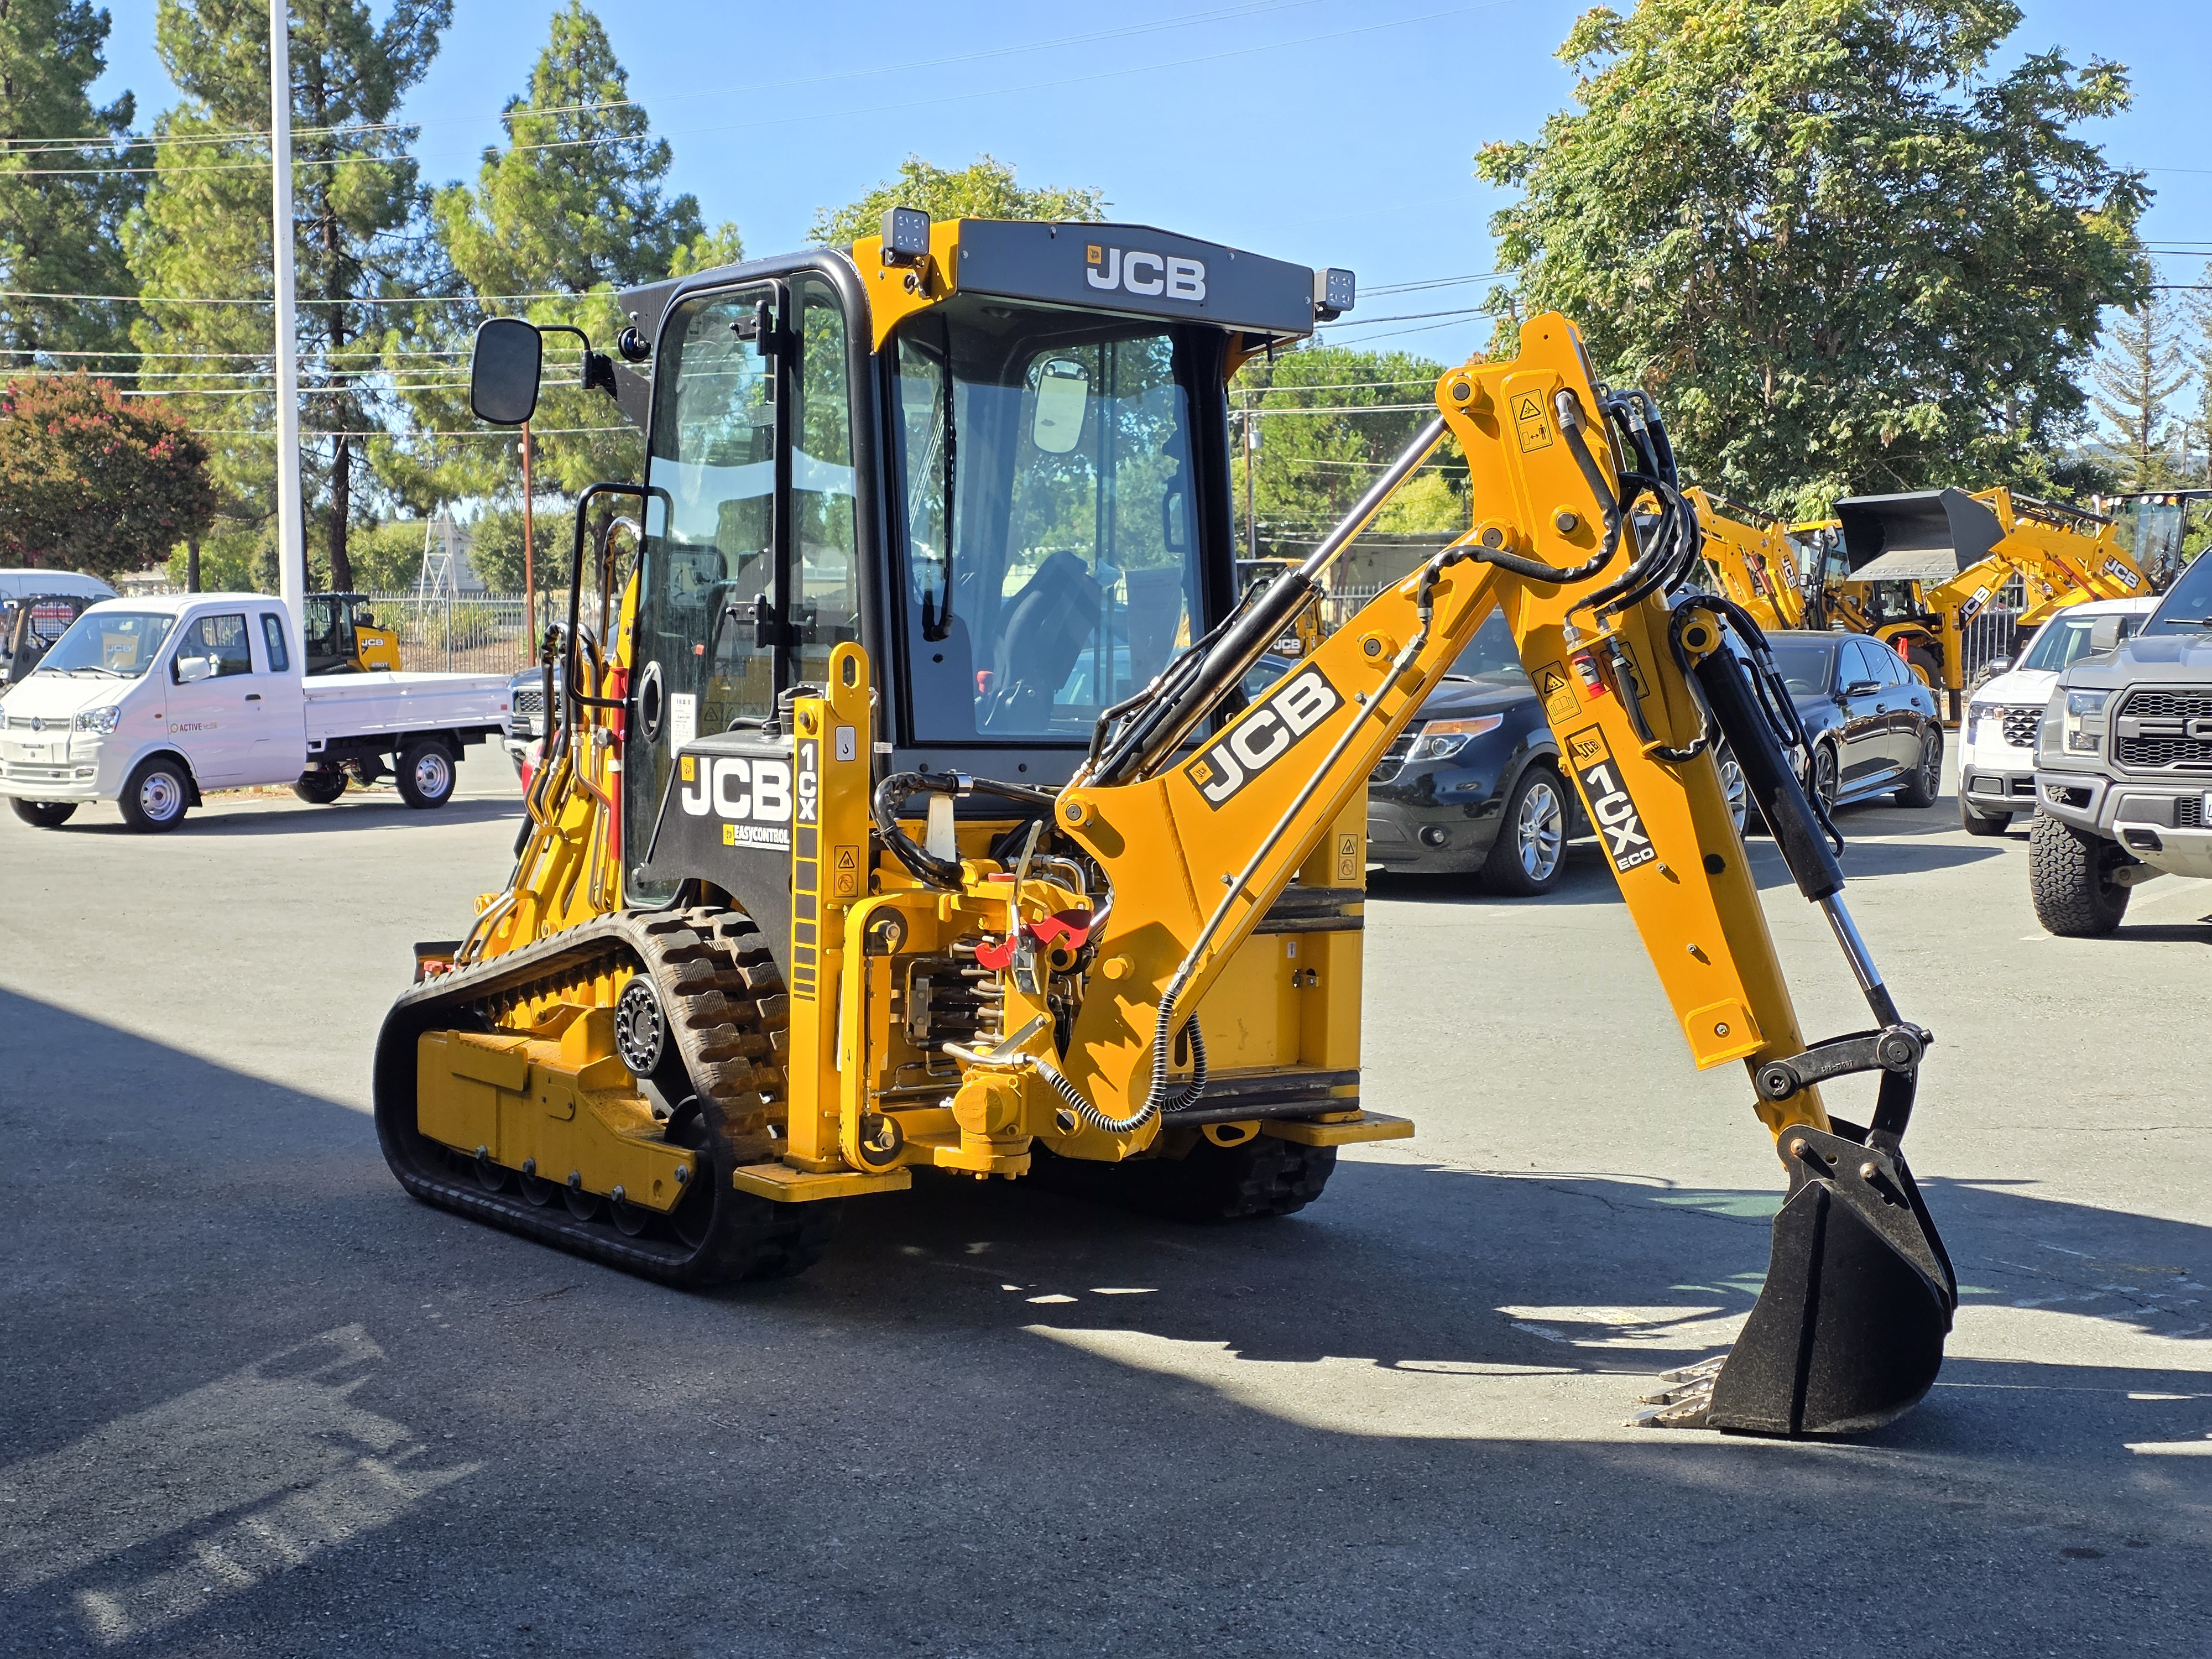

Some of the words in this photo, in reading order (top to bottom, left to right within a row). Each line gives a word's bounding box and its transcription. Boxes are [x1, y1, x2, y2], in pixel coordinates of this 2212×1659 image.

[1087, 248, 1206, 301] JCB
[1782, 557, 1797, 588] JCB
[2104, 560, 2139, 588] JCB
[1273, 639, 1300, 650] JCB
[180, 723, 202, 732] ACTIVE
[1203, 672, 1336, 801] JCB
[1577, 741, 1599, 758] JCB
[681, 758, 791, 822] JCB
[799, 743, 816, 820] 1CX
[1587, 764, 1649, 855] 1CX
[734, 825, 790, 845] EASYCONTROL
[1617, 847, 1655, 870] ECO
